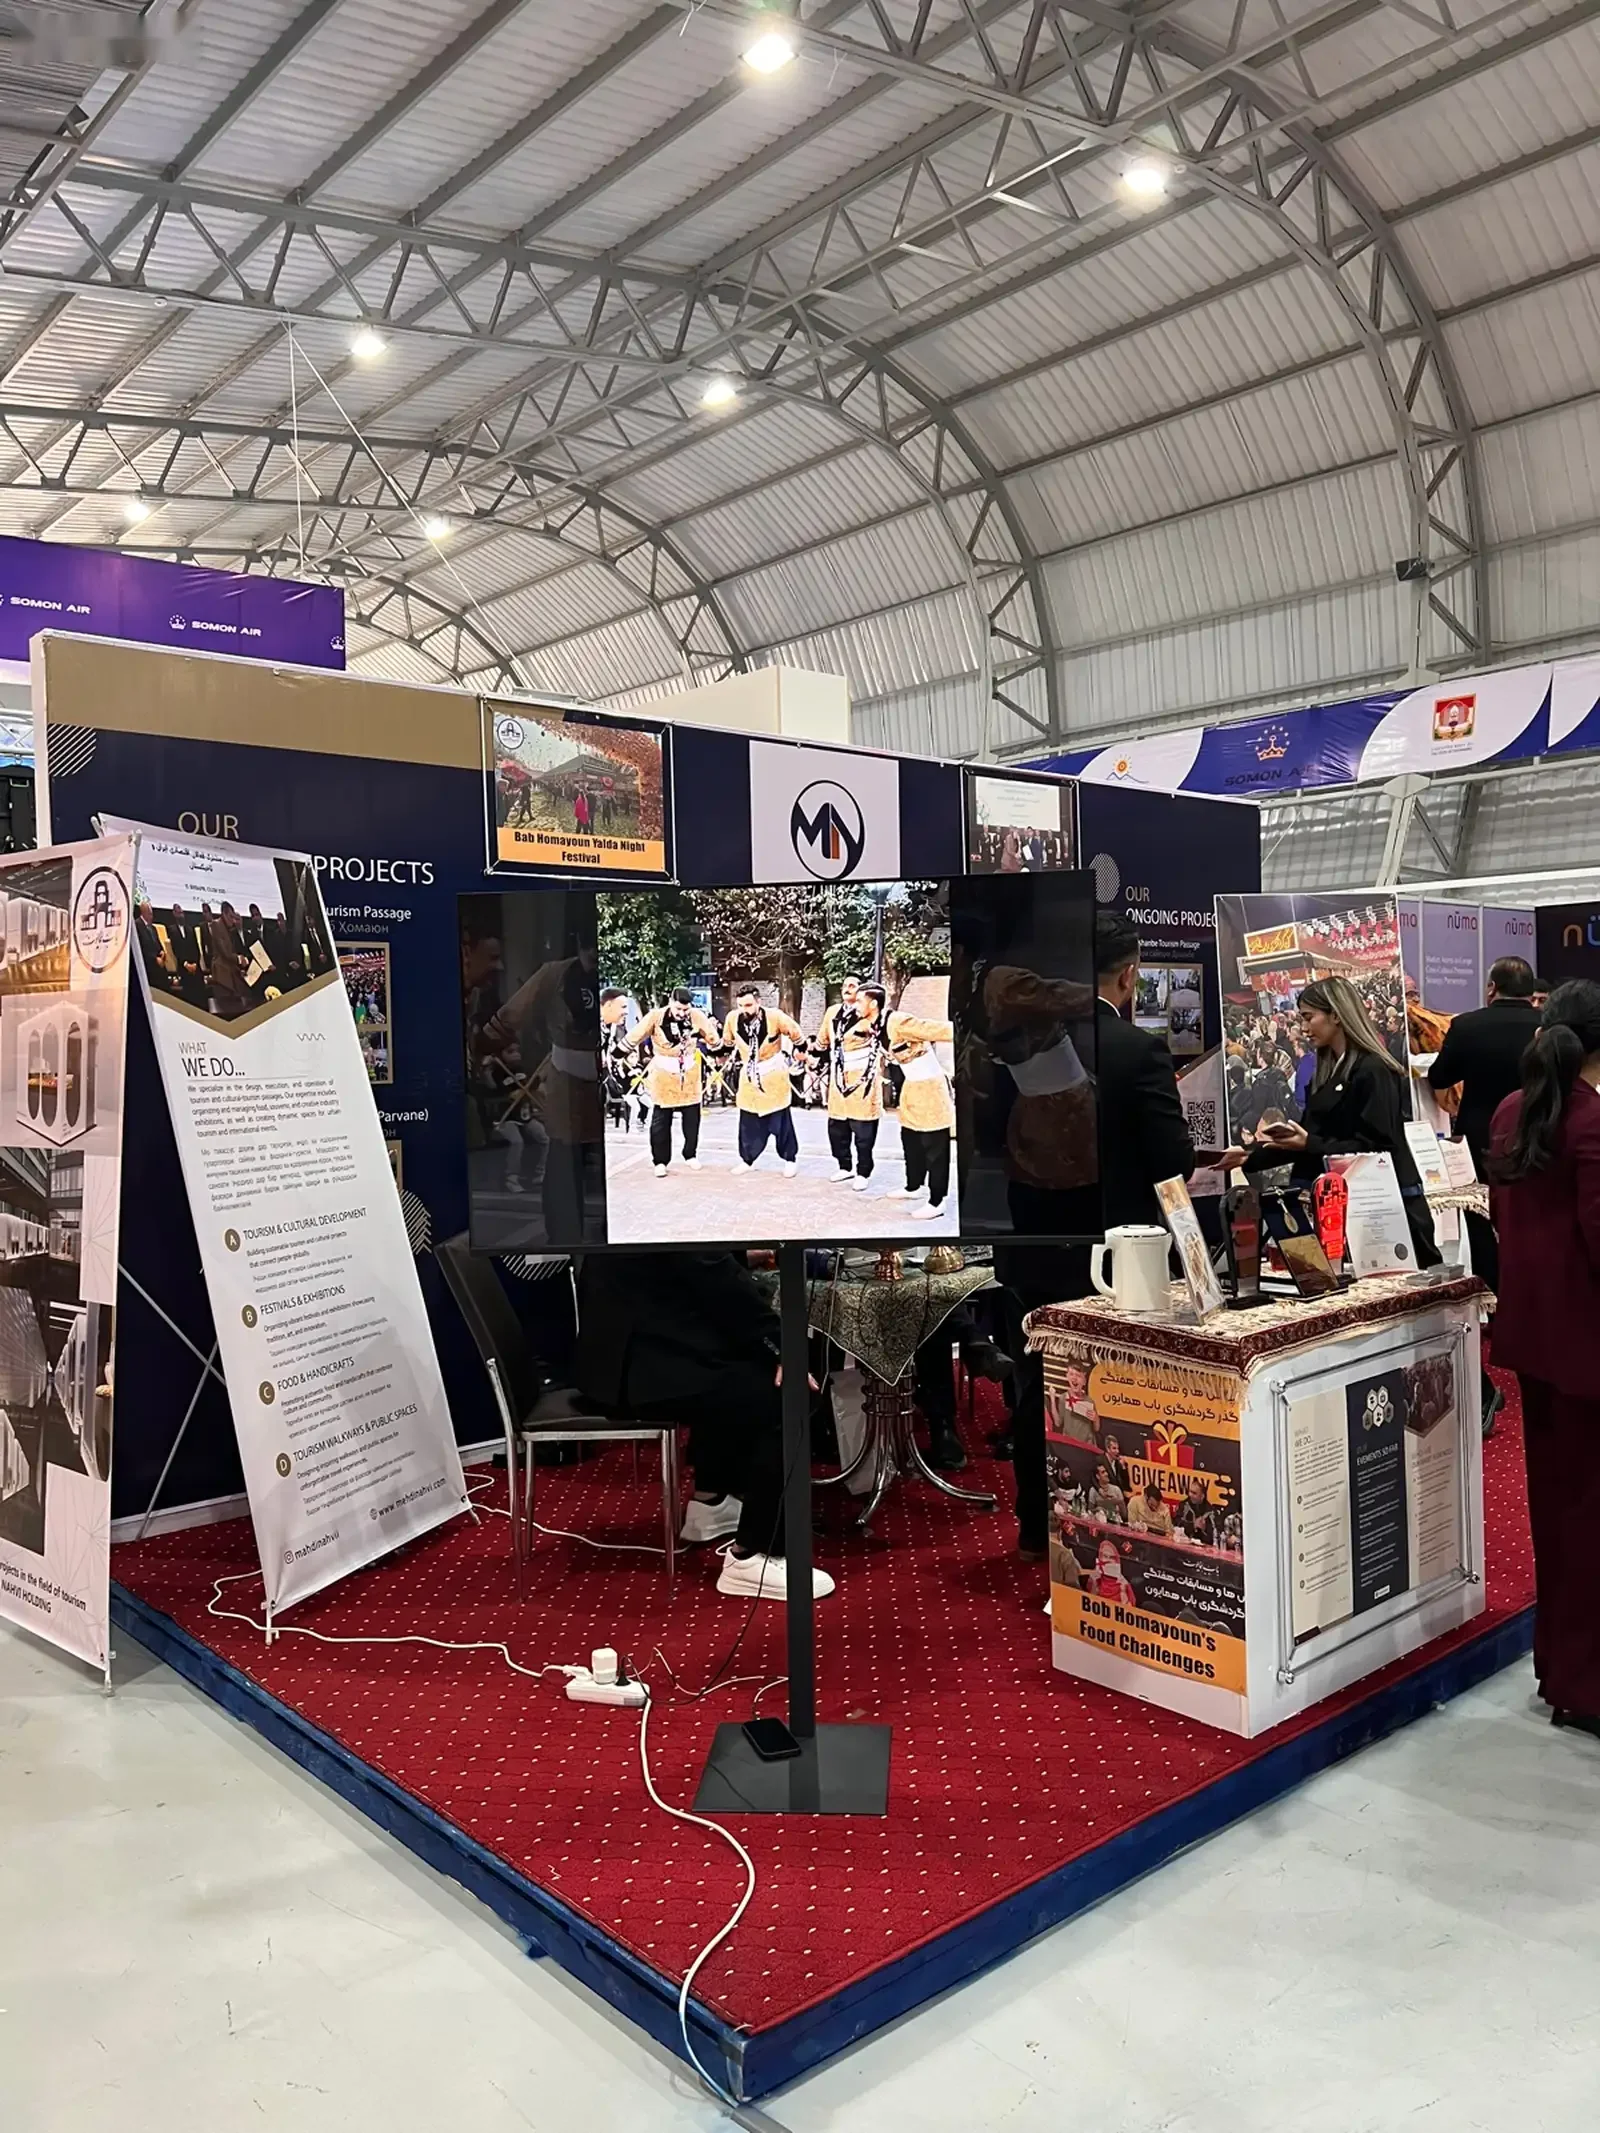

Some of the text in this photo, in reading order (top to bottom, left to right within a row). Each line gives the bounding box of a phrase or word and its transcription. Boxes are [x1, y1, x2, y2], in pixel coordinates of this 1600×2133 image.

[10, 596, 91, 615] SOMON AIR
[191, 620, 262, 637] SOMON AIR
[1224, 769, 1282, 786] SOMON
[178, 811, 239, 839] OUR
[514, 831, 645, 852] Bab Homayoun Yalda Night
[562, 851, 600, 864] Festival
[311, 855, 435, 885] PROJECTS
[1125, 886, 1150, 902] OUR
[326, 905, 412, 922] urism Passage
[1126, 908, 1217, 928] ONGOING PROJEC
[1563, 915, 1600, 947] nü
[1179, 940, 1200, 951] Passage
[178, 1042, 207, 1054] WHAT
[181, 1057, 245, 1077] WE DO...
[192, 1107, 220, 1116] organizing
[221, 1106, 231, 1114] and
[231, 1104, 256, 1113] managing
[291, 1101, 302, 1109] and
[218, 1128, 228, 1136] and
[229, 1125, 259, 1135] international
[243, 1224, 277, 1240] TOURISM
[276, 1224, 283, 1234] &
[283, 1217, 319, 1233] CULTURAL
[318, 1207, 367, 1225] DEVELOPMENT
[260, 1297, 297, 1315] FESTIVALS
[296, 1296, 303, 1306] &
[303, 1284, 346, 1304] EXHIBITIONS
[277, 1373, 300, 1391] FOOD
[300, 1373, 306, 1383] &
[306, 1356, 355, 1381] HANDICRAFTS
[1100, 1372, 1188, 1398] و مسابقات هفتگی
[1102, 1392, 1239, 1424] گذر گردشگری باب همایون
[293, 1440, 326, 1462] TOURISM
[326, 1426, 365, 1449] WALKWAYS
[365, 1423, 371, 1432] &
[371, 1413, 395, 1432] PUBLIC
[395, 1403, 418, 1421] SPACES
[1143, 1567, 1175, 1582] هفتگی
[1176, 1576, 1214, 1593] مسابقات
[0, 1561, 86, 1611] rojects in the field of tourism
[1215, 1588, 1222, 1598] و
[1223, 1586, 1236, 1598] ها
[1, 1580, 52, 1613] NAHVI HOLDING
[1145, 1586, 1245, 1619] گردشگری باب همایون
[1081, 1596, 1216, 1652] Bob Homayoun's
[1080, 1621, 1215, 1679] Food Challenges
